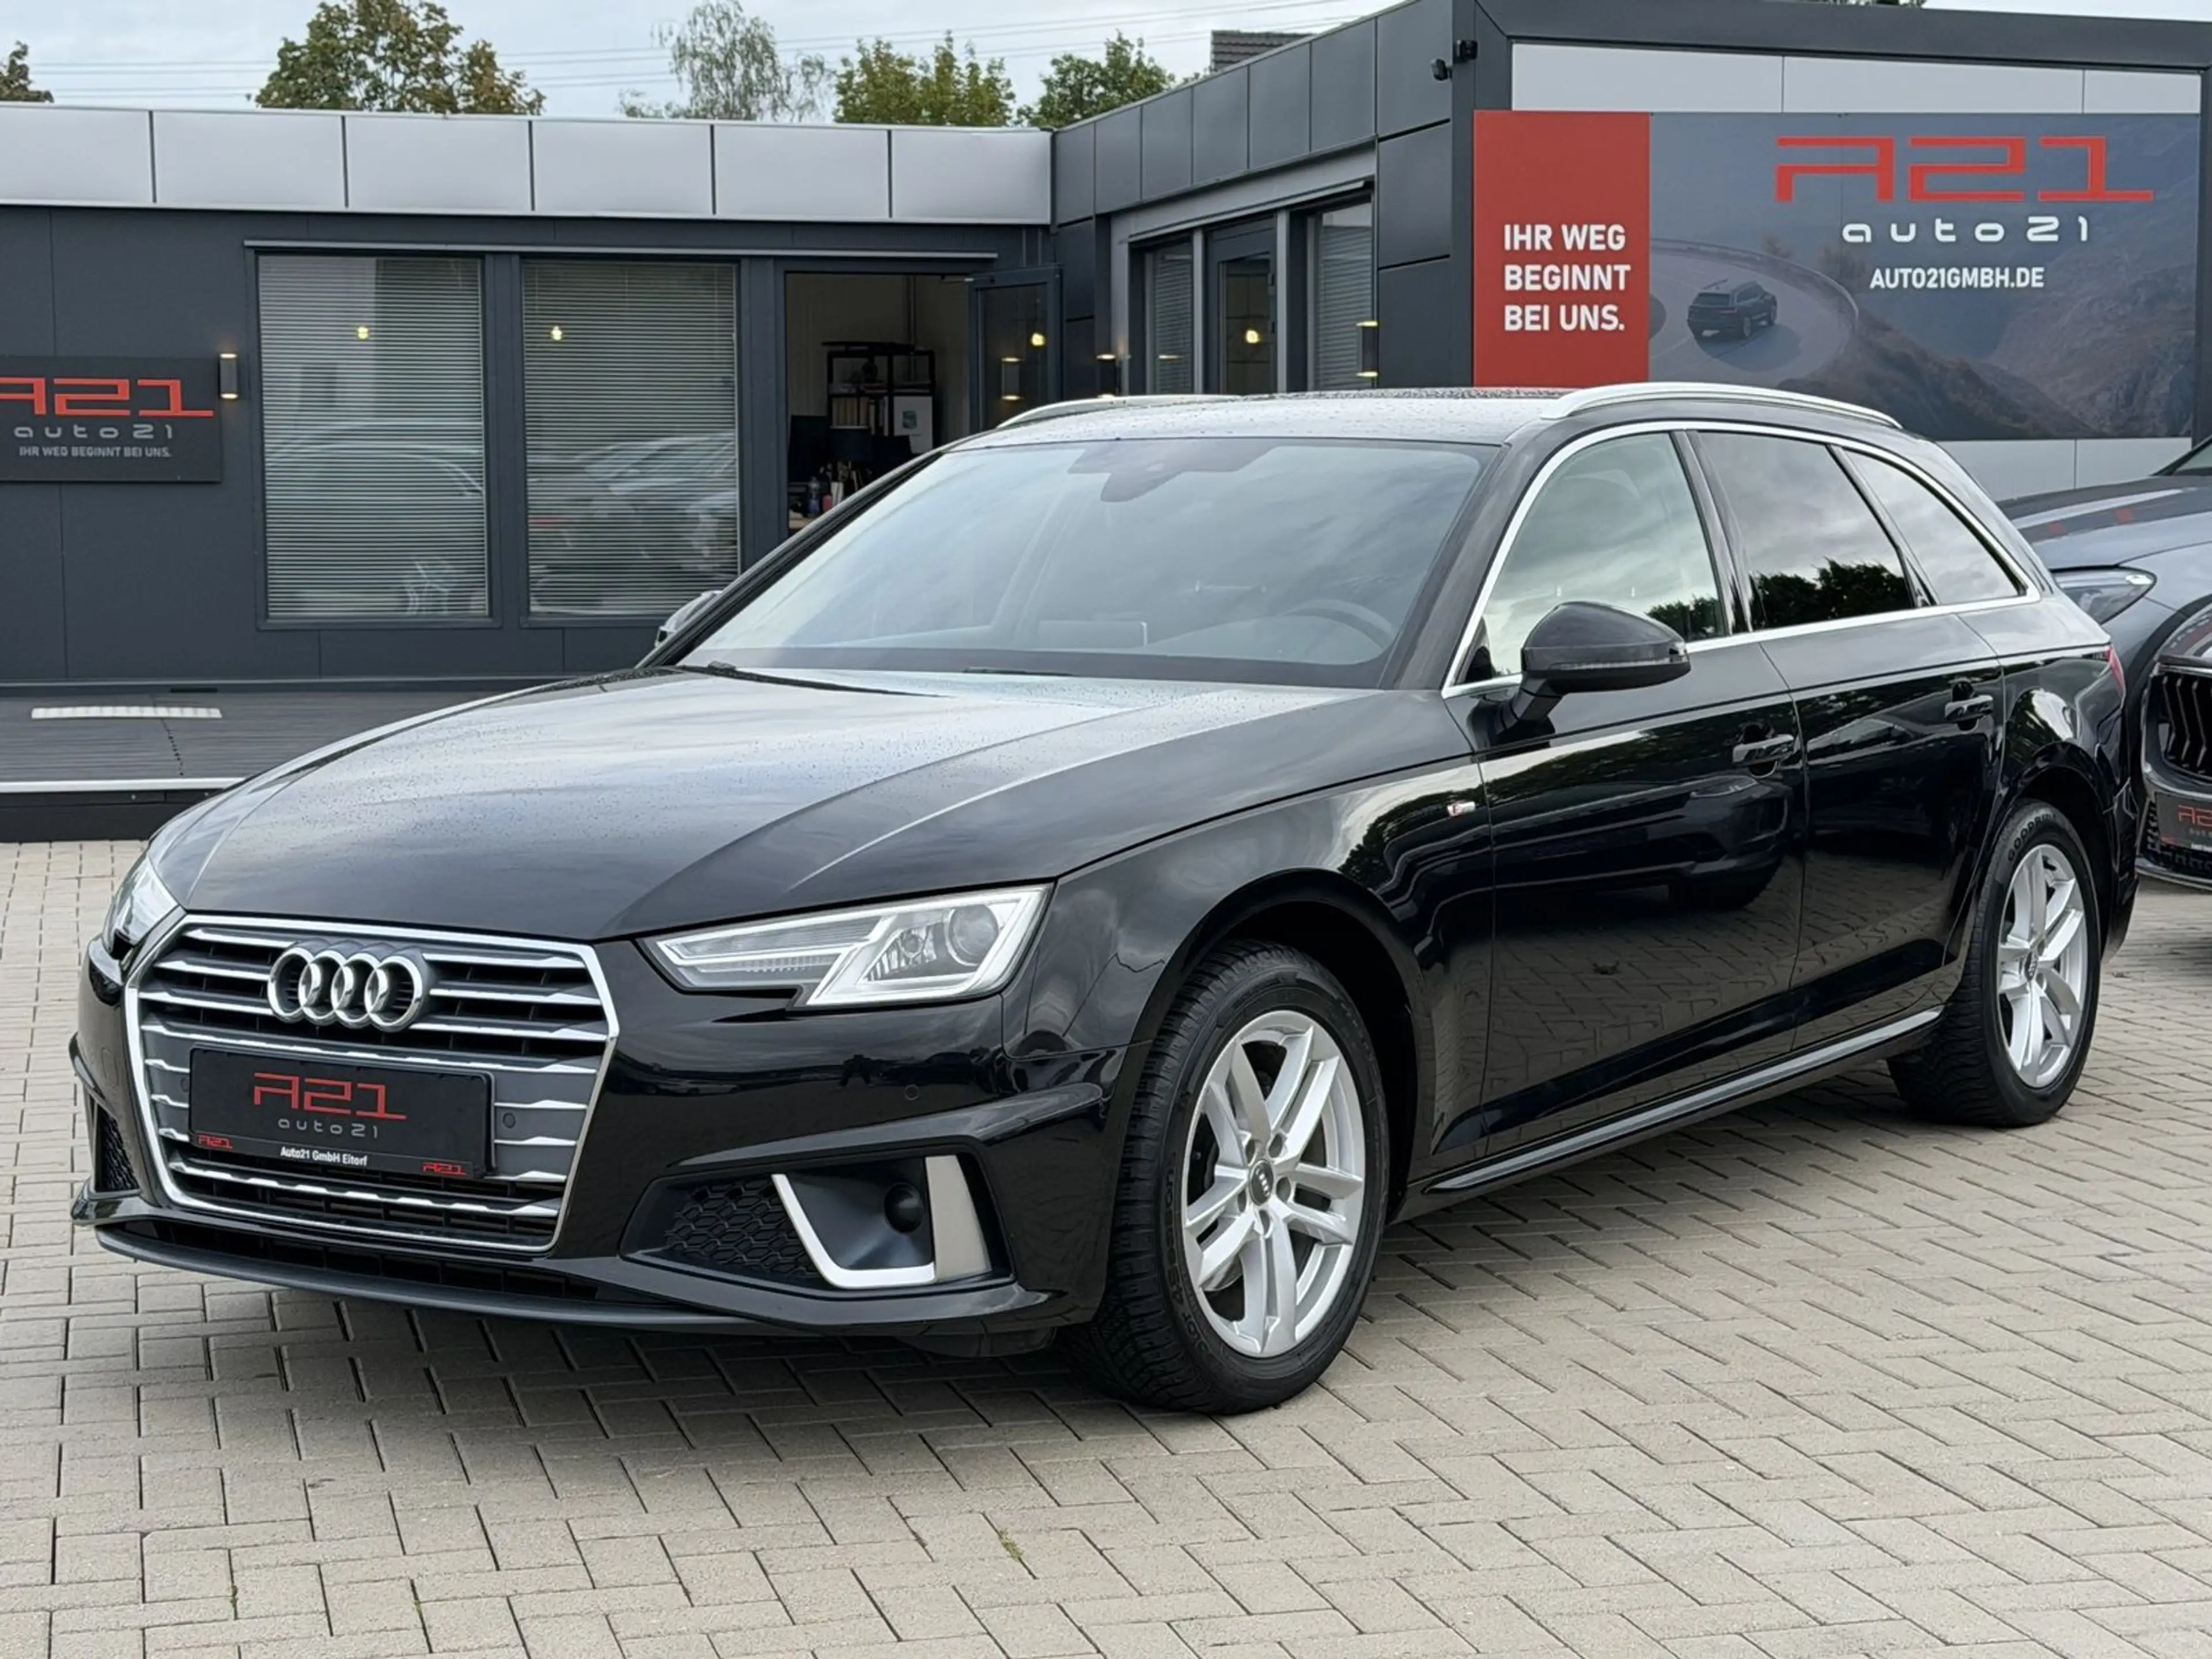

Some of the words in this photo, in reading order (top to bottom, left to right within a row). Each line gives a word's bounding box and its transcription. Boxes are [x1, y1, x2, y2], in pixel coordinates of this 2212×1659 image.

[1775, 136, 2154, 202] A21
[1504, 224, 1553, 251] IHR
[1560, 224, 1626, 251] WEG
[1504, 264, 1631, 291] BEGINNT
[1870, 267, 2045, 289] AUTO21GMBH.DE
[1504, 304, 1550, 332] BEI
[1559, 304, 1625, 332] UNS.
[19, 446, 39, 457] IHR
[43, 446, 68, 457] WEG
[71, 446, 121, 457] BEGINNT
[124, 446, 142, 457] BEI
[145, 446, 172, 457] UNS.
[254, 1073, 406, 1120] A21
[280, 1146, 310, 1160] Auto21
[312, 1150, 341, 1162] GmbH
[342, 1153, 368, 1166] Eitorf
